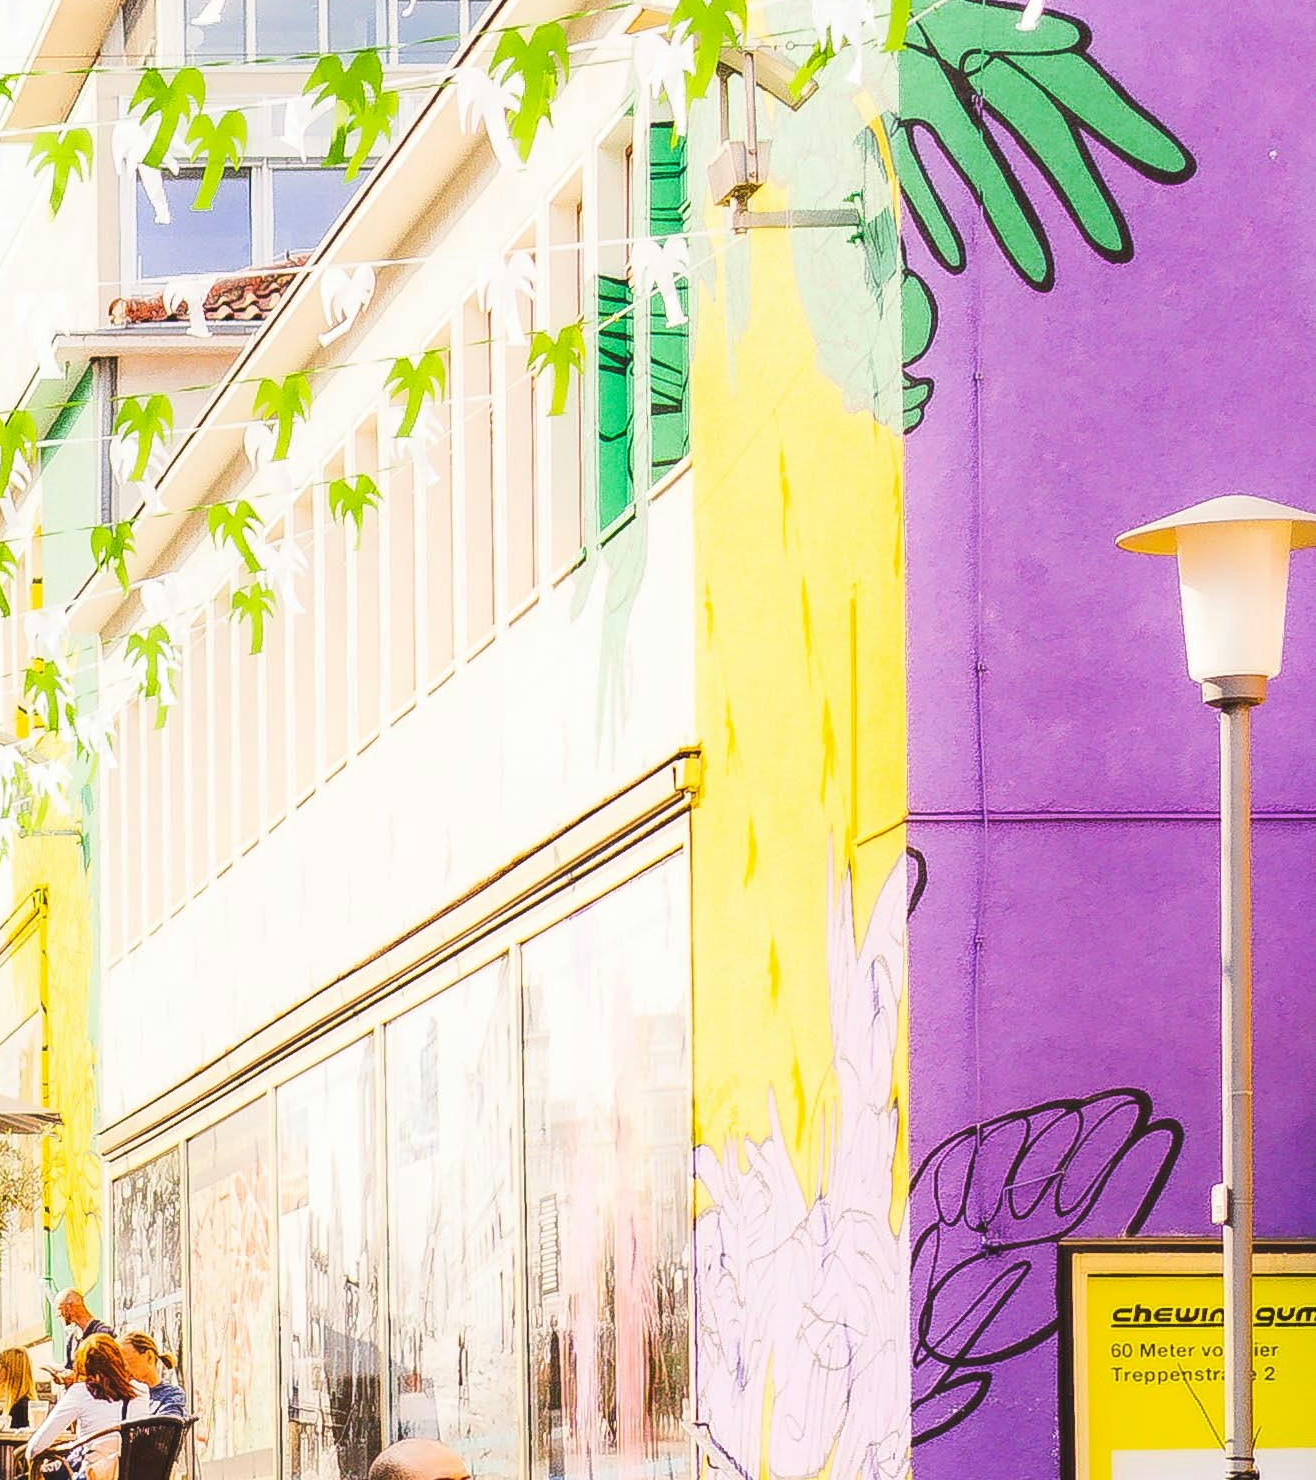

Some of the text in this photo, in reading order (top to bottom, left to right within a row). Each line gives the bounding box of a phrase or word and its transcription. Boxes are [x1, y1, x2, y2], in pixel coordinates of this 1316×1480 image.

[1112, 1304, 1225, 1323] chewin
[1111, 1342, 1279, 1358] 60 Meter vo ier
[1264, 1366, 1276, 1381] 2
